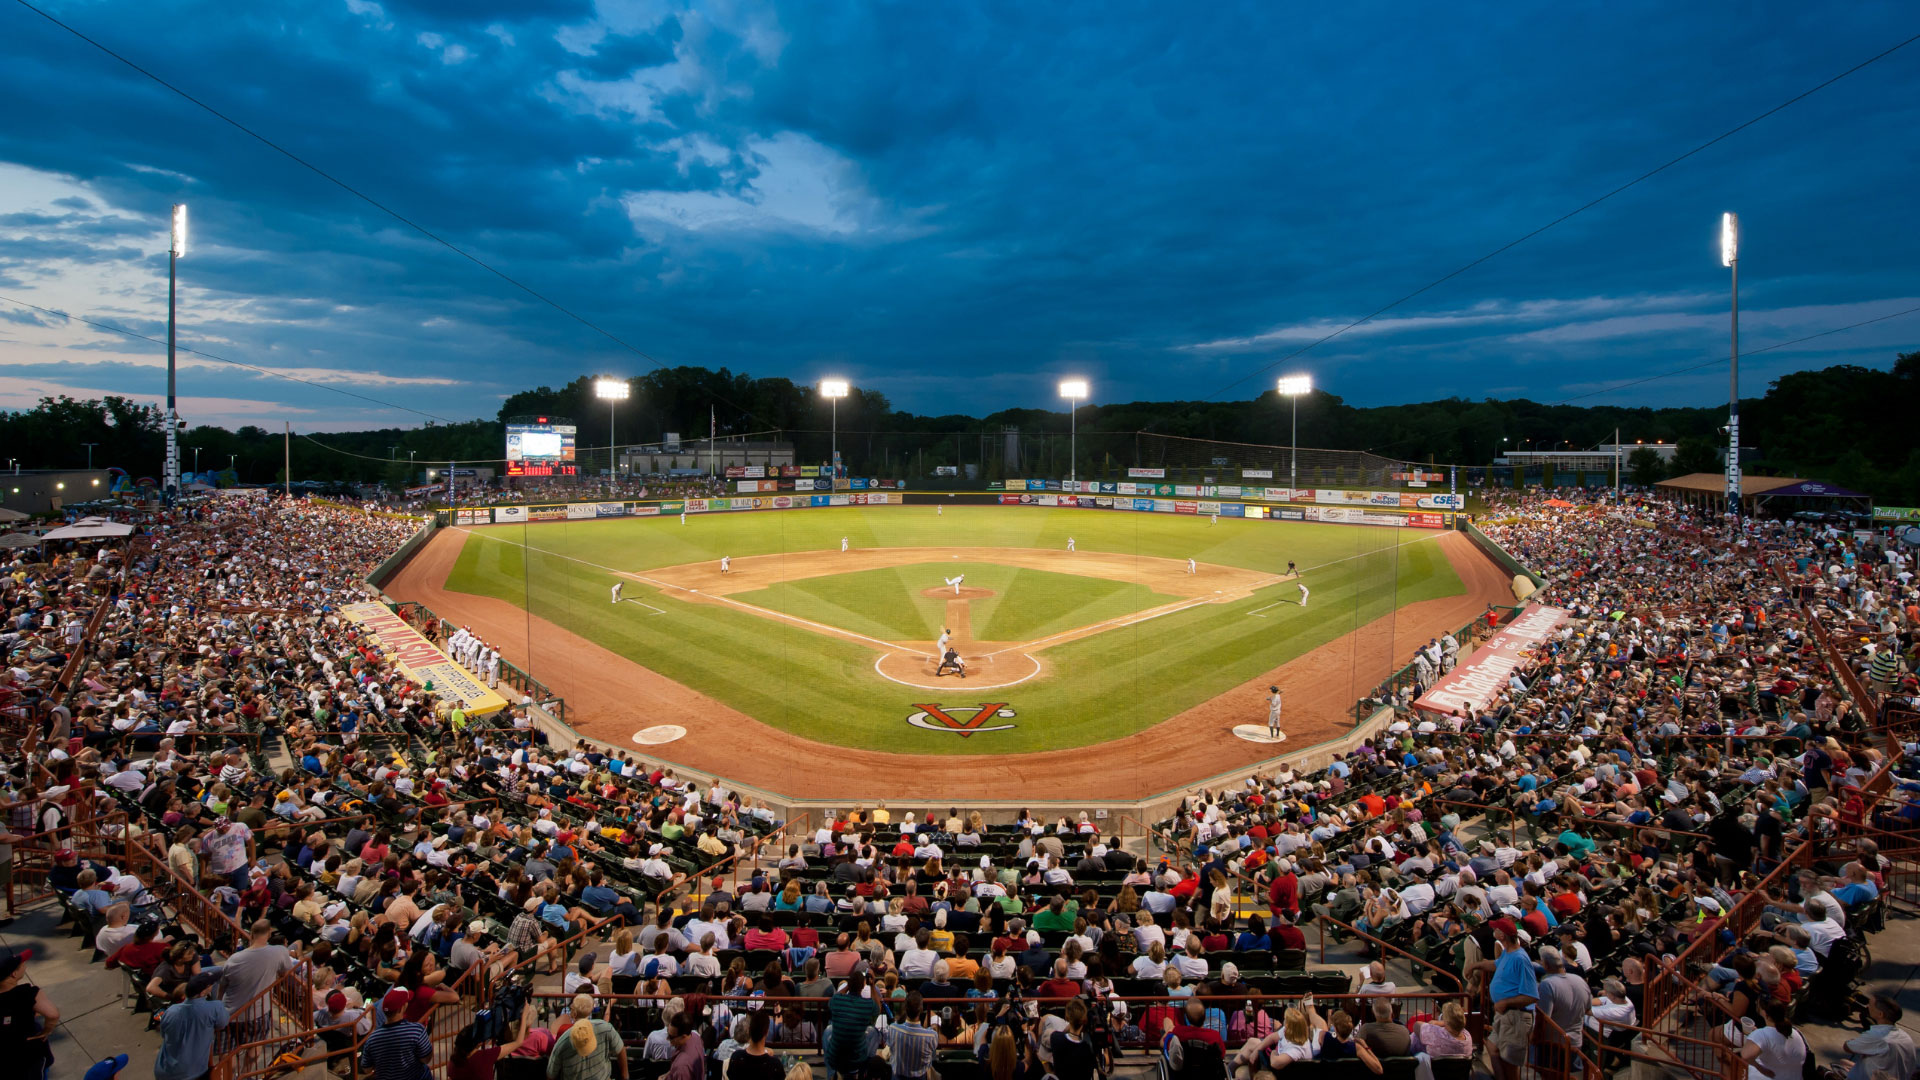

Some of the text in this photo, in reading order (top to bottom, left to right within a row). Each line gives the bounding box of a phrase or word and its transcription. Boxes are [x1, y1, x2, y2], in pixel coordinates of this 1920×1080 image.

[1729, 414, 1739, 493] sunmark
[1197, 485, 1218, 496] Jif
[1874, 508, 1908, 520] Buddy's
[1505, 641, 1518, 650] Go
